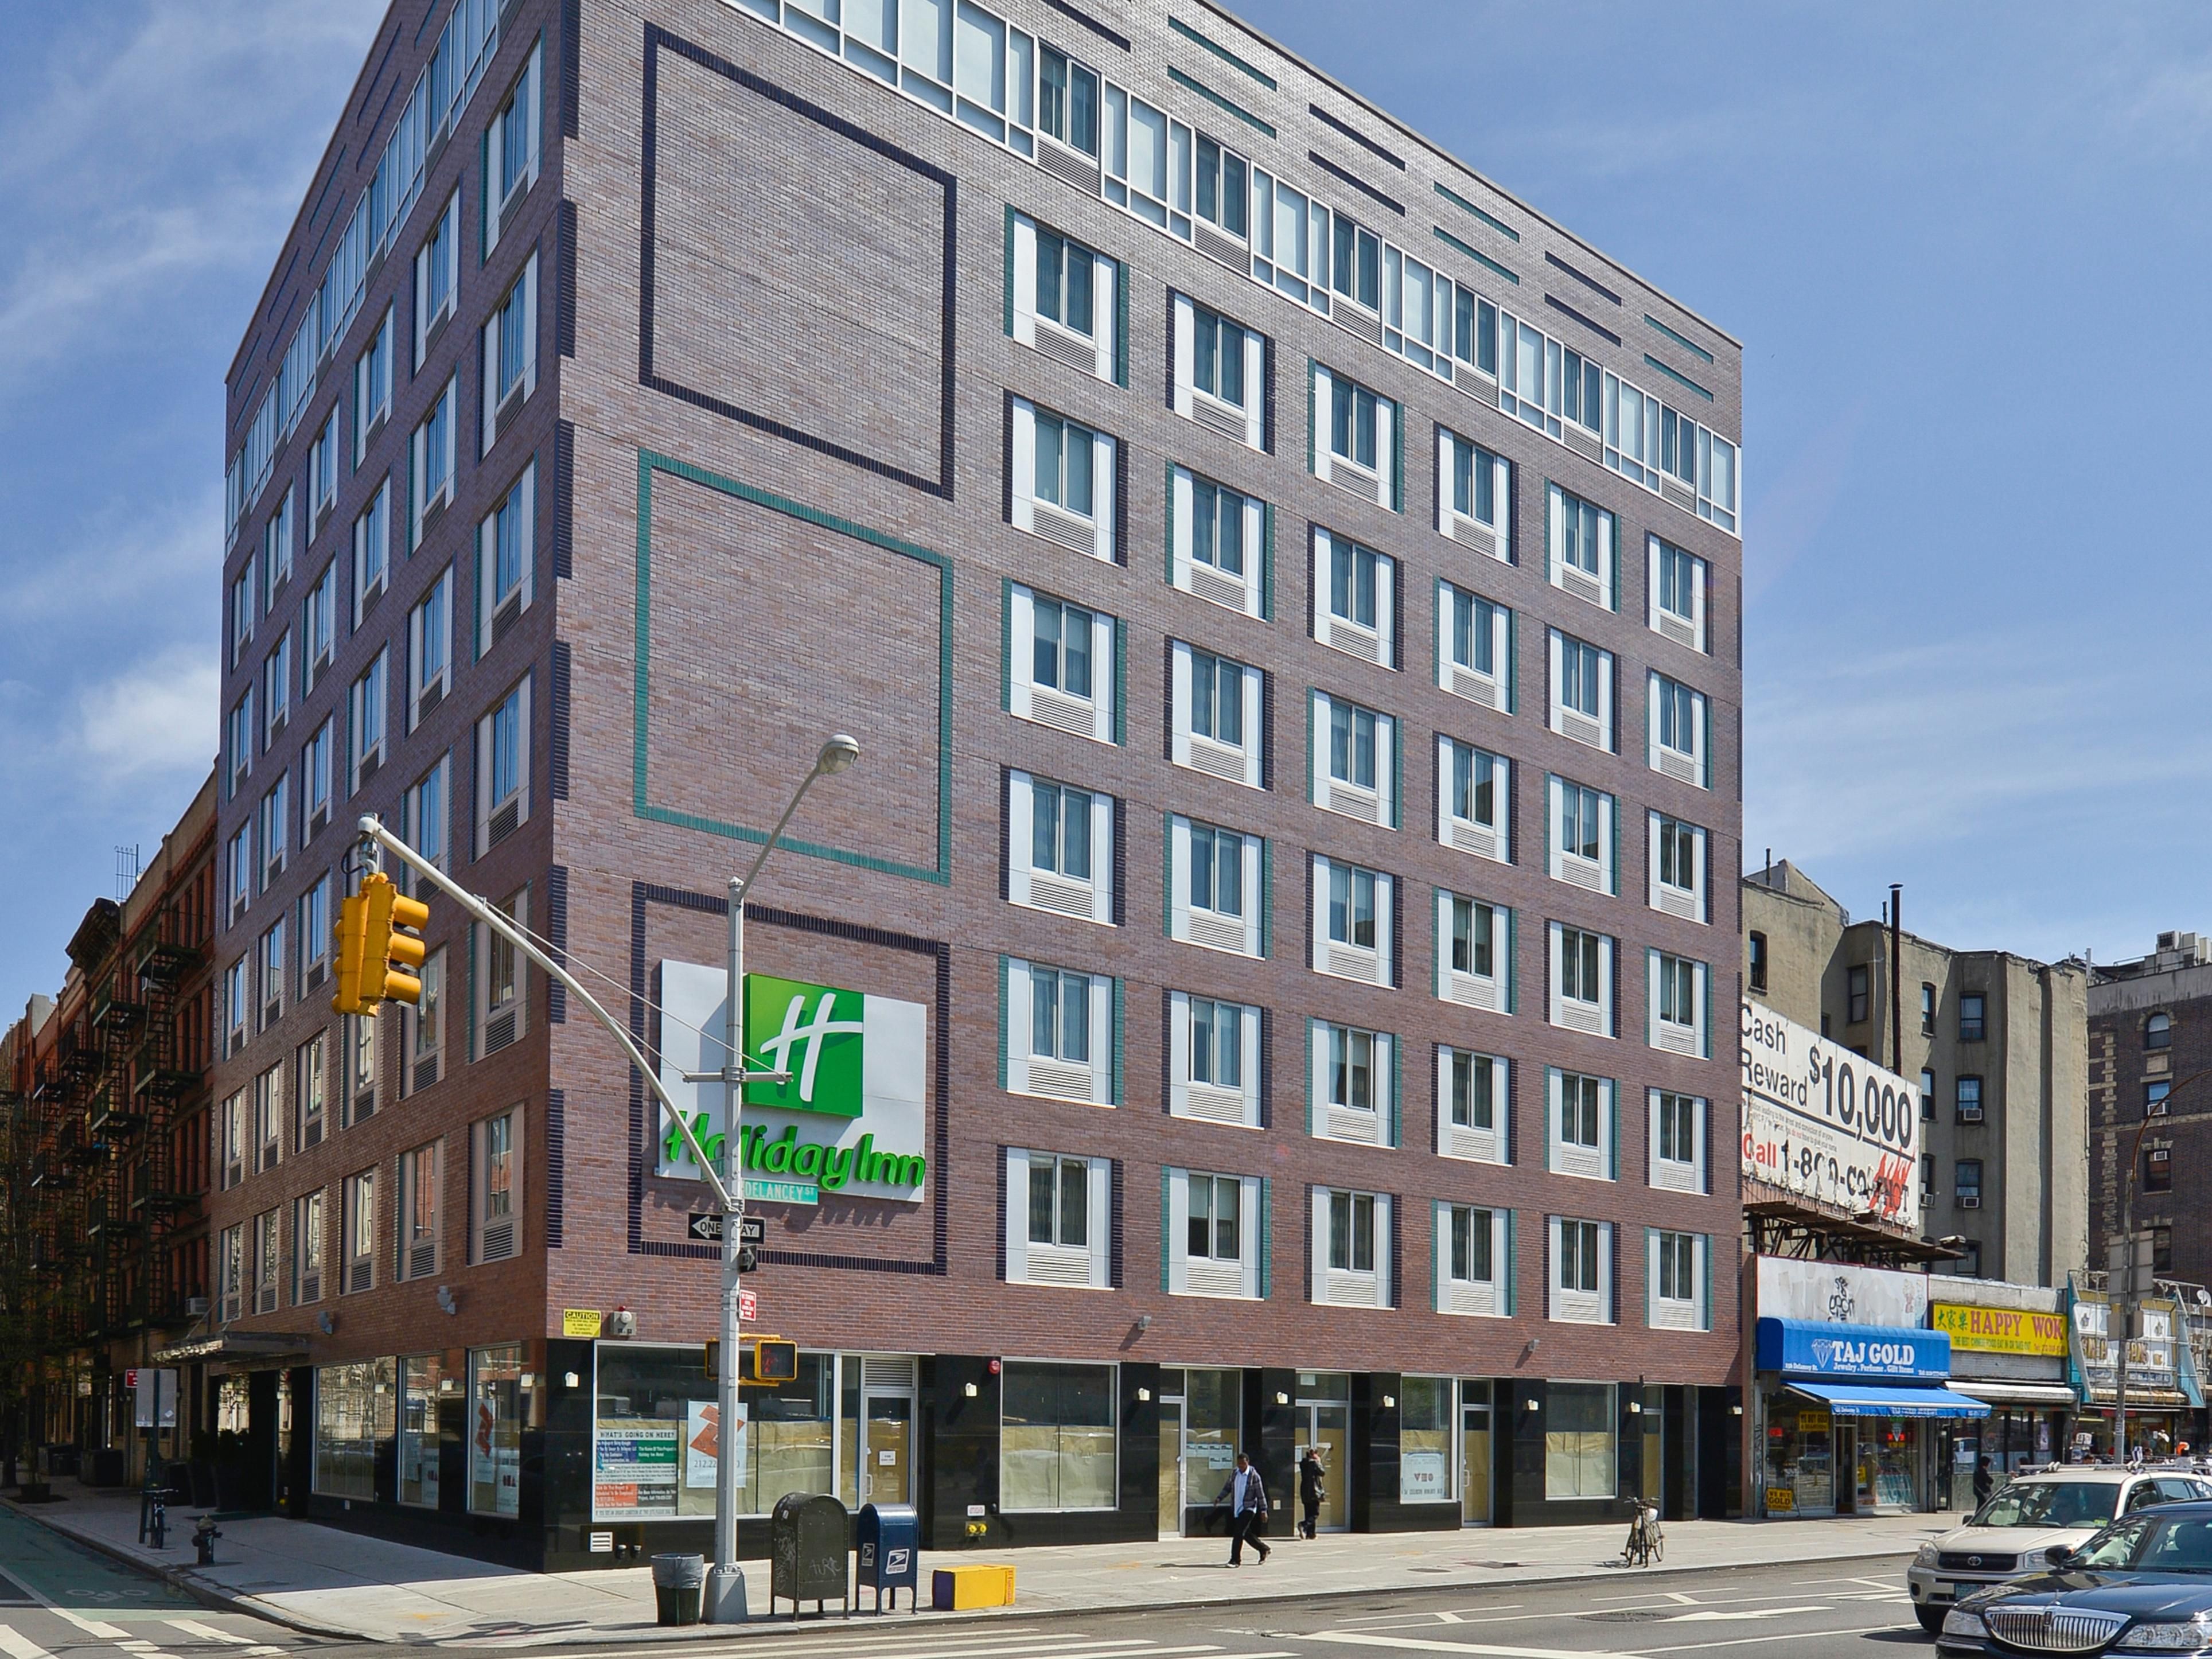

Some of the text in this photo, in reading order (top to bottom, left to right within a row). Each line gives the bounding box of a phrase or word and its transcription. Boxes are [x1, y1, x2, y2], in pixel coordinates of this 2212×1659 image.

[1742, 1003, 1786, 1054] Cash
[1742, 1047, 1808, 1107] Reward
[1809, 1043, 1912, 1149] $10,000
[666, 1111, 926, 1191] Holiday Inn
[1742, 1132, 1777, 1168] Call
[745, 1181, 803, 1201] DELANCEY
[700, 1221, 755, 1236] ONE AY
[1970, 1310, 2063, 1340] HAPPY WOK
[1832, 1340, 1915, 1365] TAJ GOLD
[1833, 1362, 1856, 1372] Jewelry
[1769, 1497, 1790, 1505] GOLD
